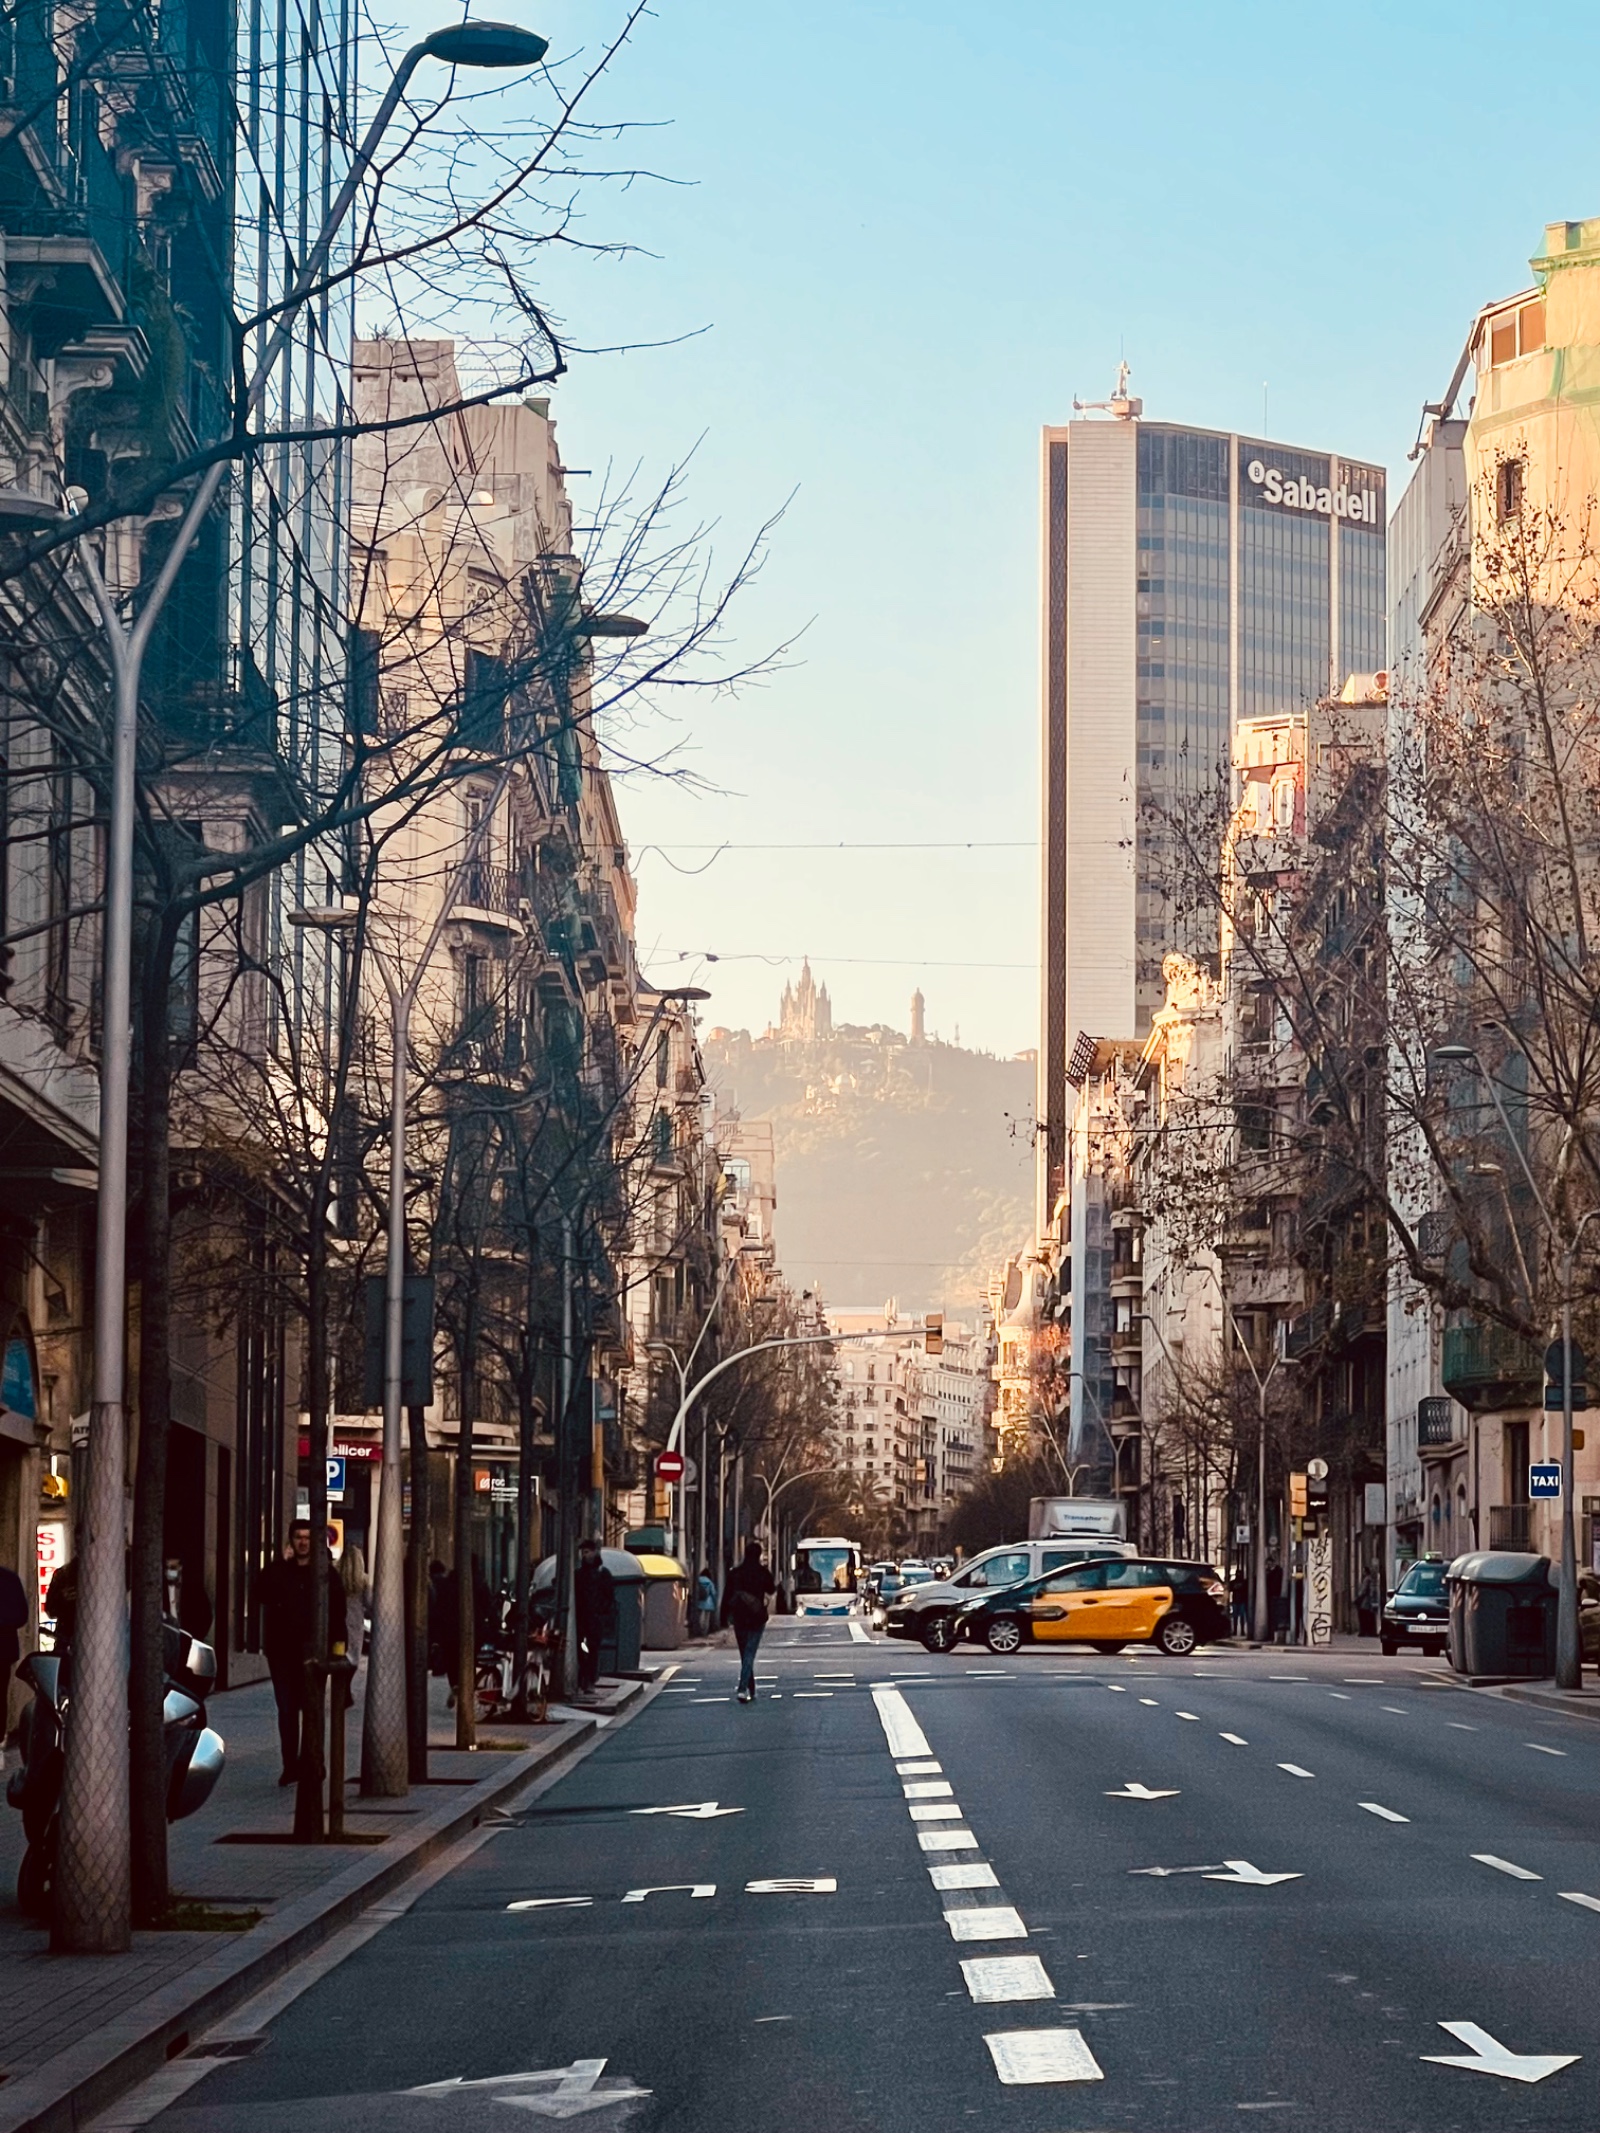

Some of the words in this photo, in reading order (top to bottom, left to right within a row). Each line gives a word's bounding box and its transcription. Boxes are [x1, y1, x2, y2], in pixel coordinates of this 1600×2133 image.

[1263, 468, 1377, 524] Sabadell
[327, 1444, 372, 1457] ellicer
[326, 1460, 340, 1487] P
[1531, 1475, 1559, 1487] TAXI
